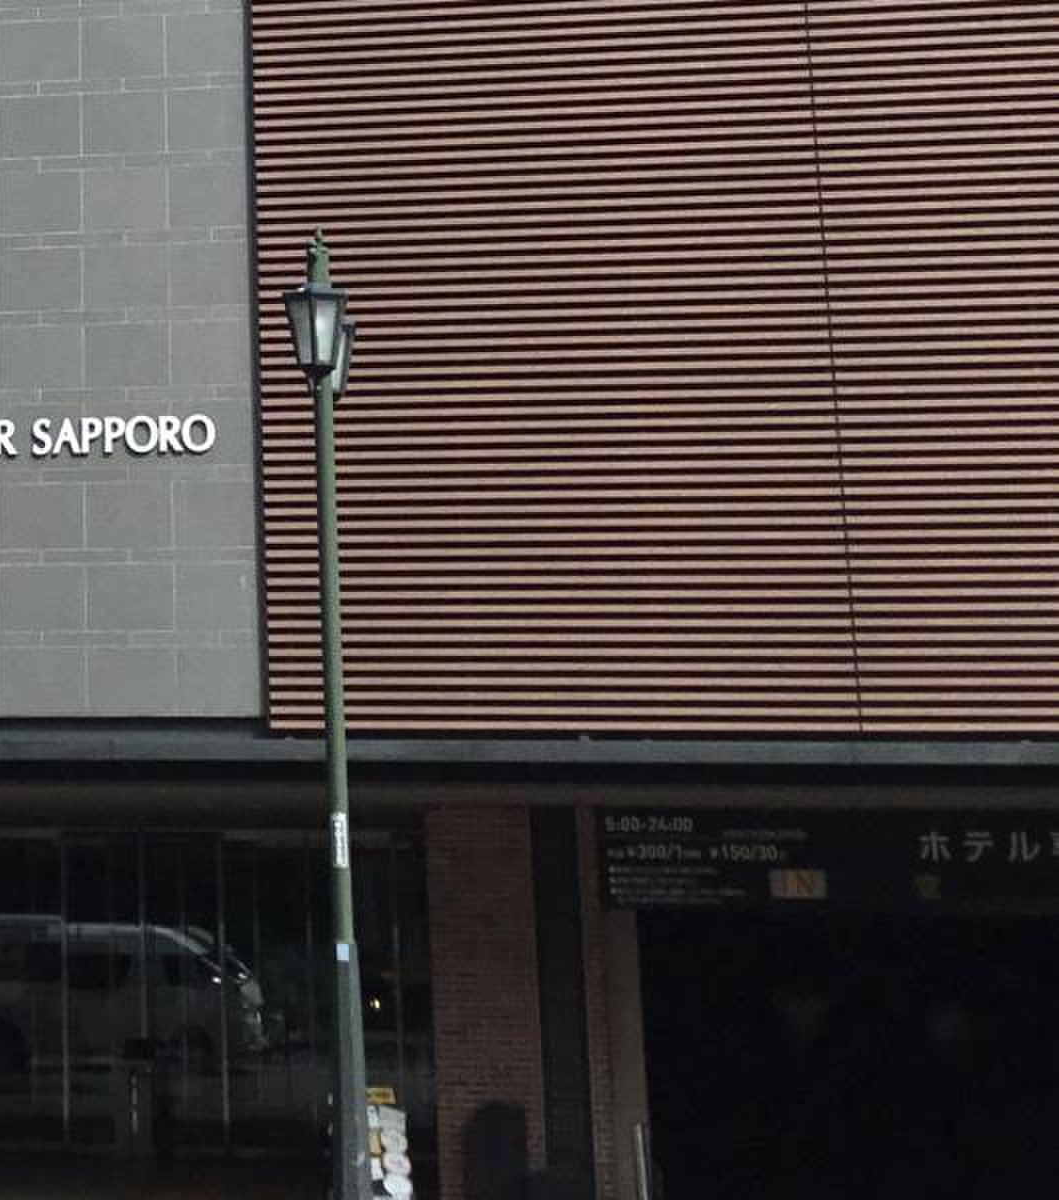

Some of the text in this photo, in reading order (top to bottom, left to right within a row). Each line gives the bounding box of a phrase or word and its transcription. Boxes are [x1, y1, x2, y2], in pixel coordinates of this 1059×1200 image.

[31, 413, 216, 457] SAPPORO
[916, 831, 1059, 864] ホテル
